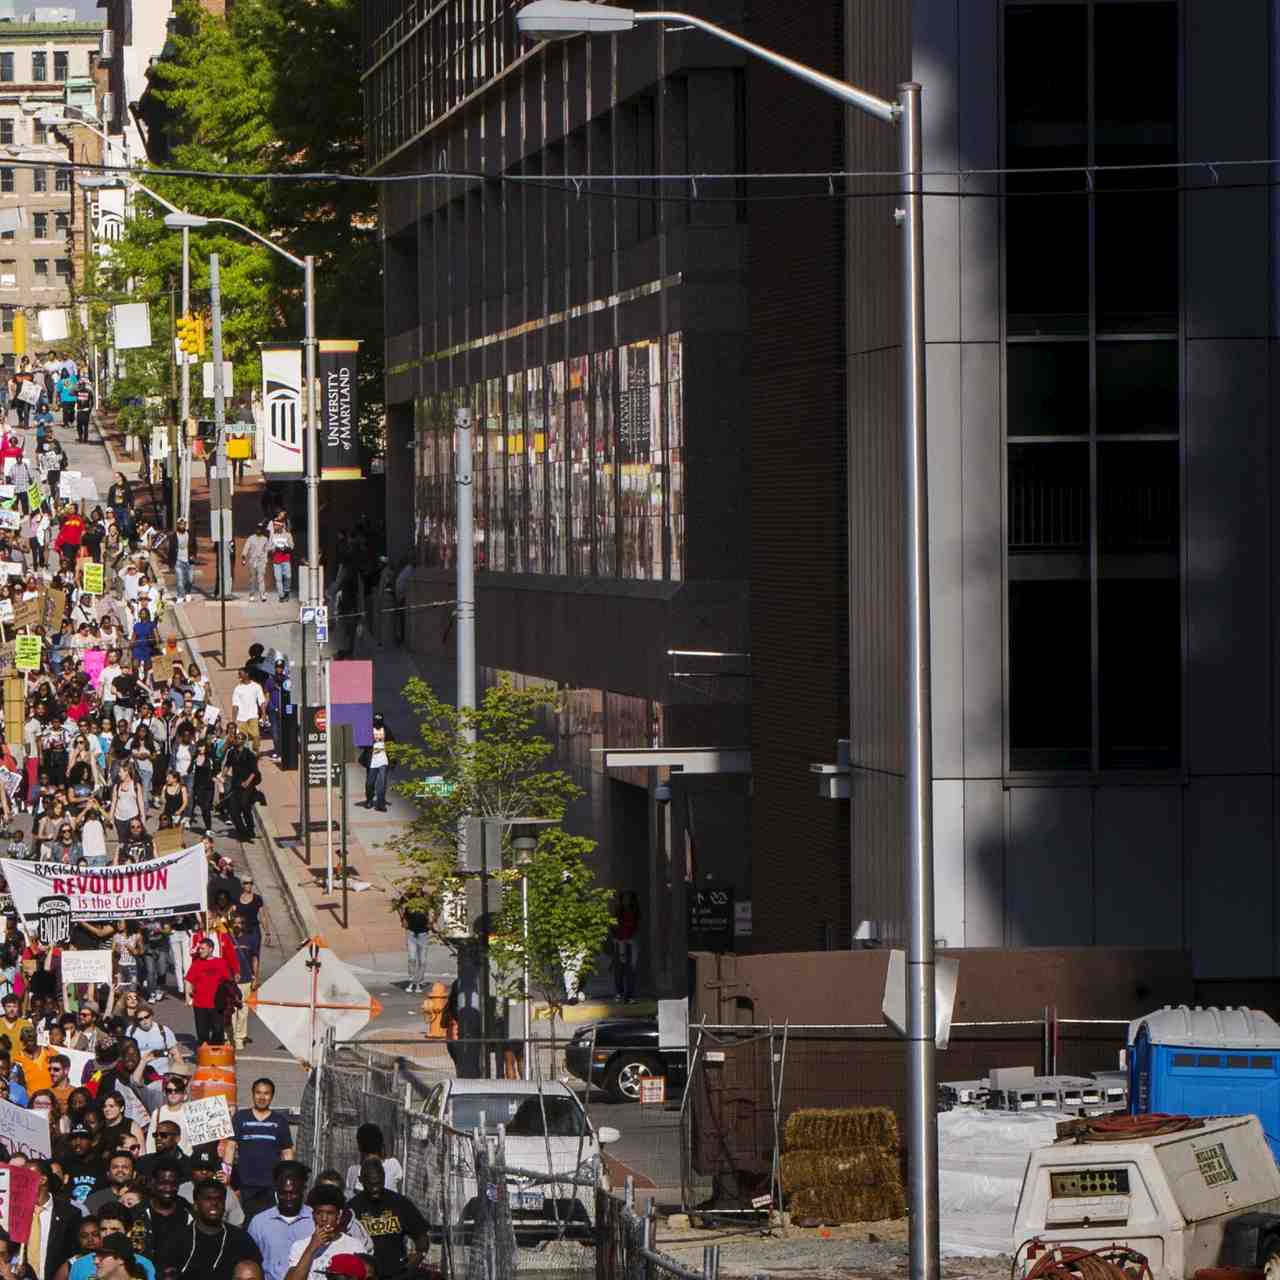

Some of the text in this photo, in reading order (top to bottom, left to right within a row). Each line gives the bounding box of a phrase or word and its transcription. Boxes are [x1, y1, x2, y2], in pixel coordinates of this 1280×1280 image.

[328, 371, 339, 447] UNIVERSITY
[339, 367, 352, 450] of MARYLAND
[34, 863, 81, 876] RACISM
[53, 869, 168, 894] REVOLUTION
[78, 897, 88, 909] is
[92, 896, 111, 909] the
[116, 894, 146, 909] Cure!
